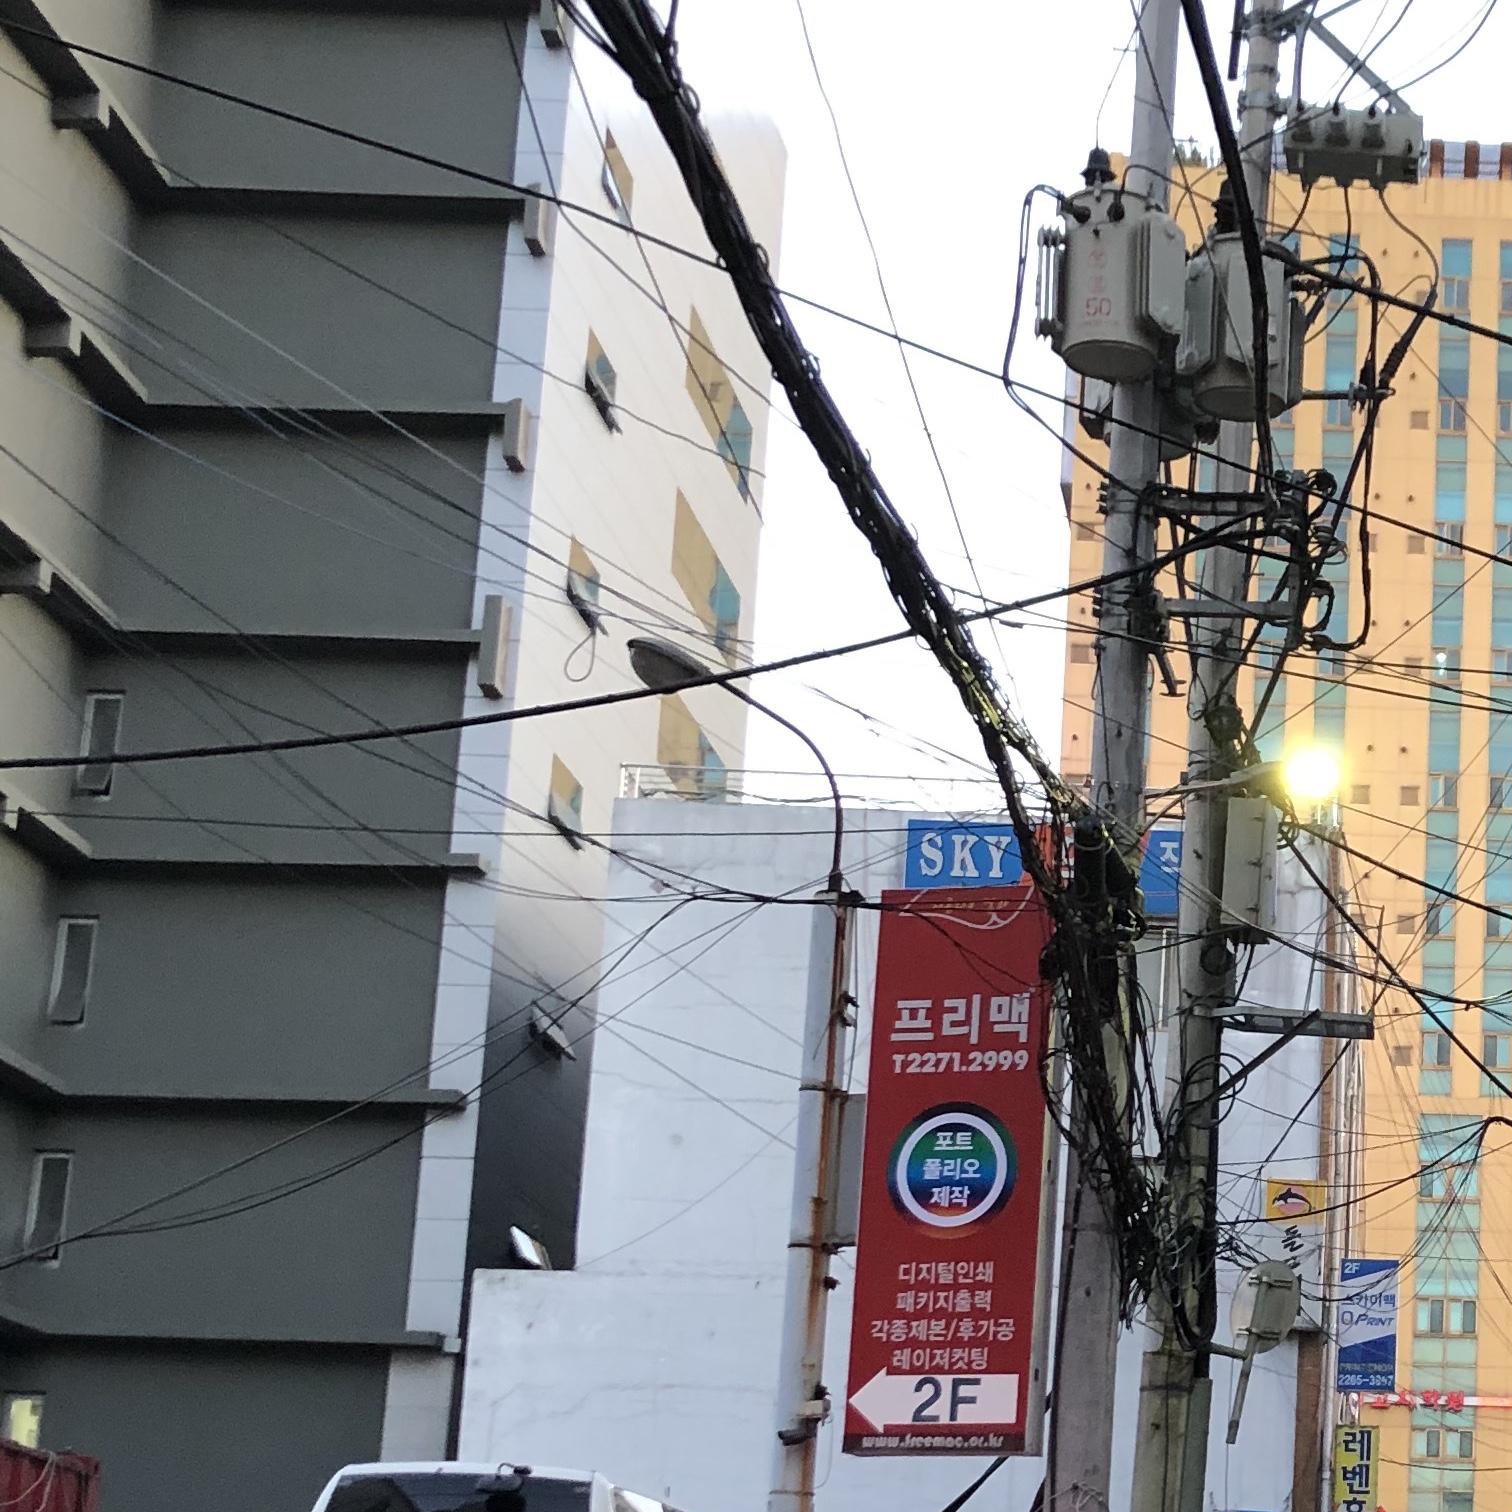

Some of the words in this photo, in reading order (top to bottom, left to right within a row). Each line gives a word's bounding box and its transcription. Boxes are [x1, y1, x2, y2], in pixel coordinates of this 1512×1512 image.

[1085, 297, 1112, 317] 50
[920, 831, 1012, 878] SKY
[890, 992, 1031, 1045] 프리맥
[892, 1050, 1029, 1074] T2271.2999
[933, 1131, 973, 1152] 포트
[921, 1158, 982, 1181] 폴리오
[929, 1185, 971, 1209] 제작
[898, 1261, 994, 1284] 디지털인쇄
[1344, 1262, 1360, 1274] 2F
[896, 1290, 992, 1313] 패키지출력
[871, 1318, 1015, 1342] 각종제본/후가공
[892, 1347, 989, 1370] 레이져컷팅
[912, 1377, 981, 1423] 2F
